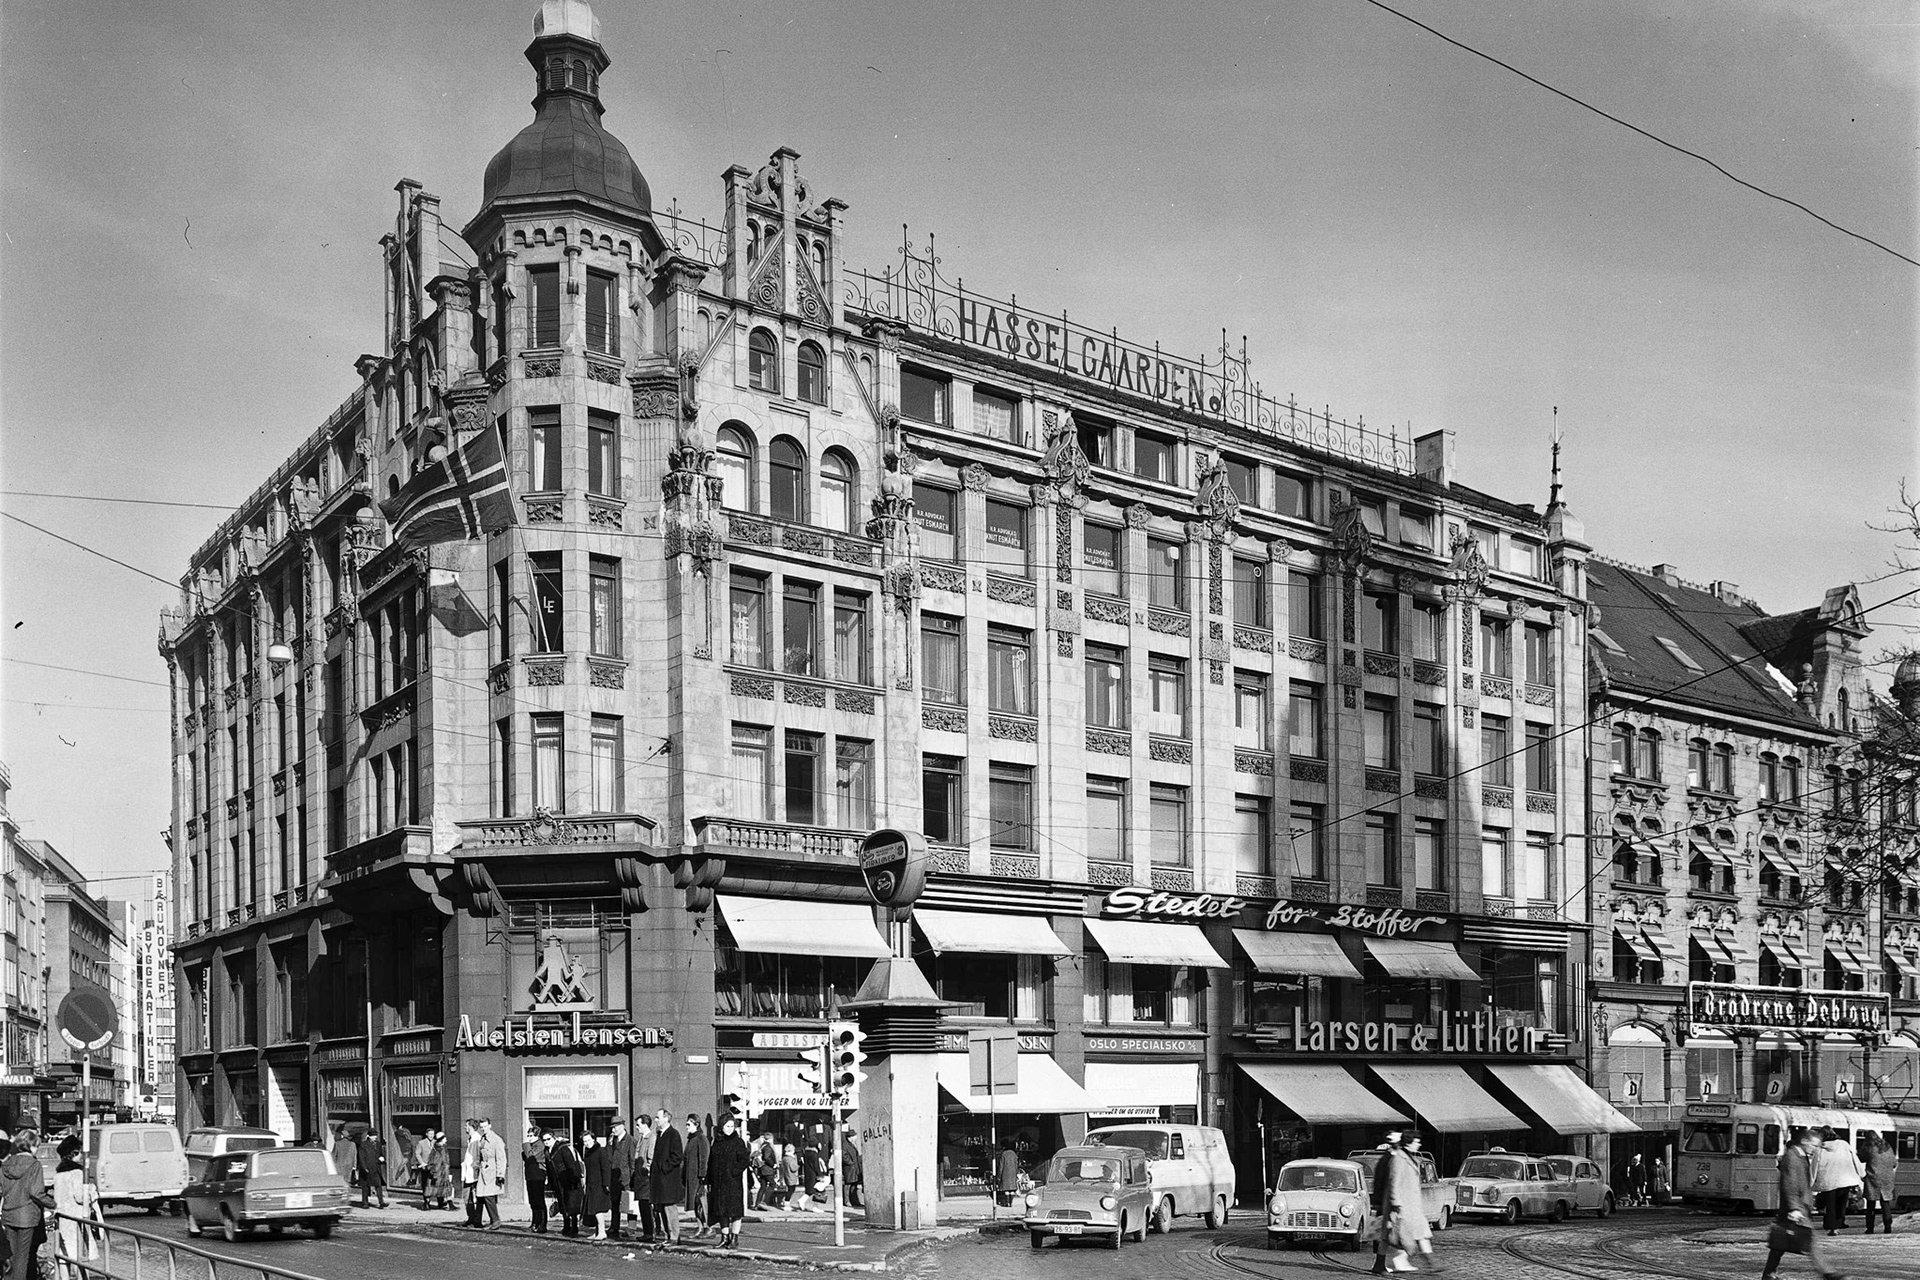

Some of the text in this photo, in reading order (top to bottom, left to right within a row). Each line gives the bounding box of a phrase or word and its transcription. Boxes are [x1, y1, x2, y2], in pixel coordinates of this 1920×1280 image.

[959, 300, 1206, 412] HASSELGAARDEN
[1104, 887, 1447, 937] Stedet for Stoffer
[144, 931, 156, 1083] BYGGEARTIKLER
[455, 1014, 564, 1047] Adelsten
[571, 1011, 659, 1045] Jensen
[1295, 1006, 1536, 1053] Larsen & Lütken
[1089, 1039, 1118, 1049] OSLO
[1121, 1039, 1186, 1051] SPECIALSKO
[0, 1075, 34, 1085] WALD
[1628, 1081, 1638, 1096] D
[1703, 1081, 1712, 1096] D
[791, 1097, 803, 1107] OM
[806, 1097, 817, 1107] OG
[1696, 1161, 1711, 1172] 238
